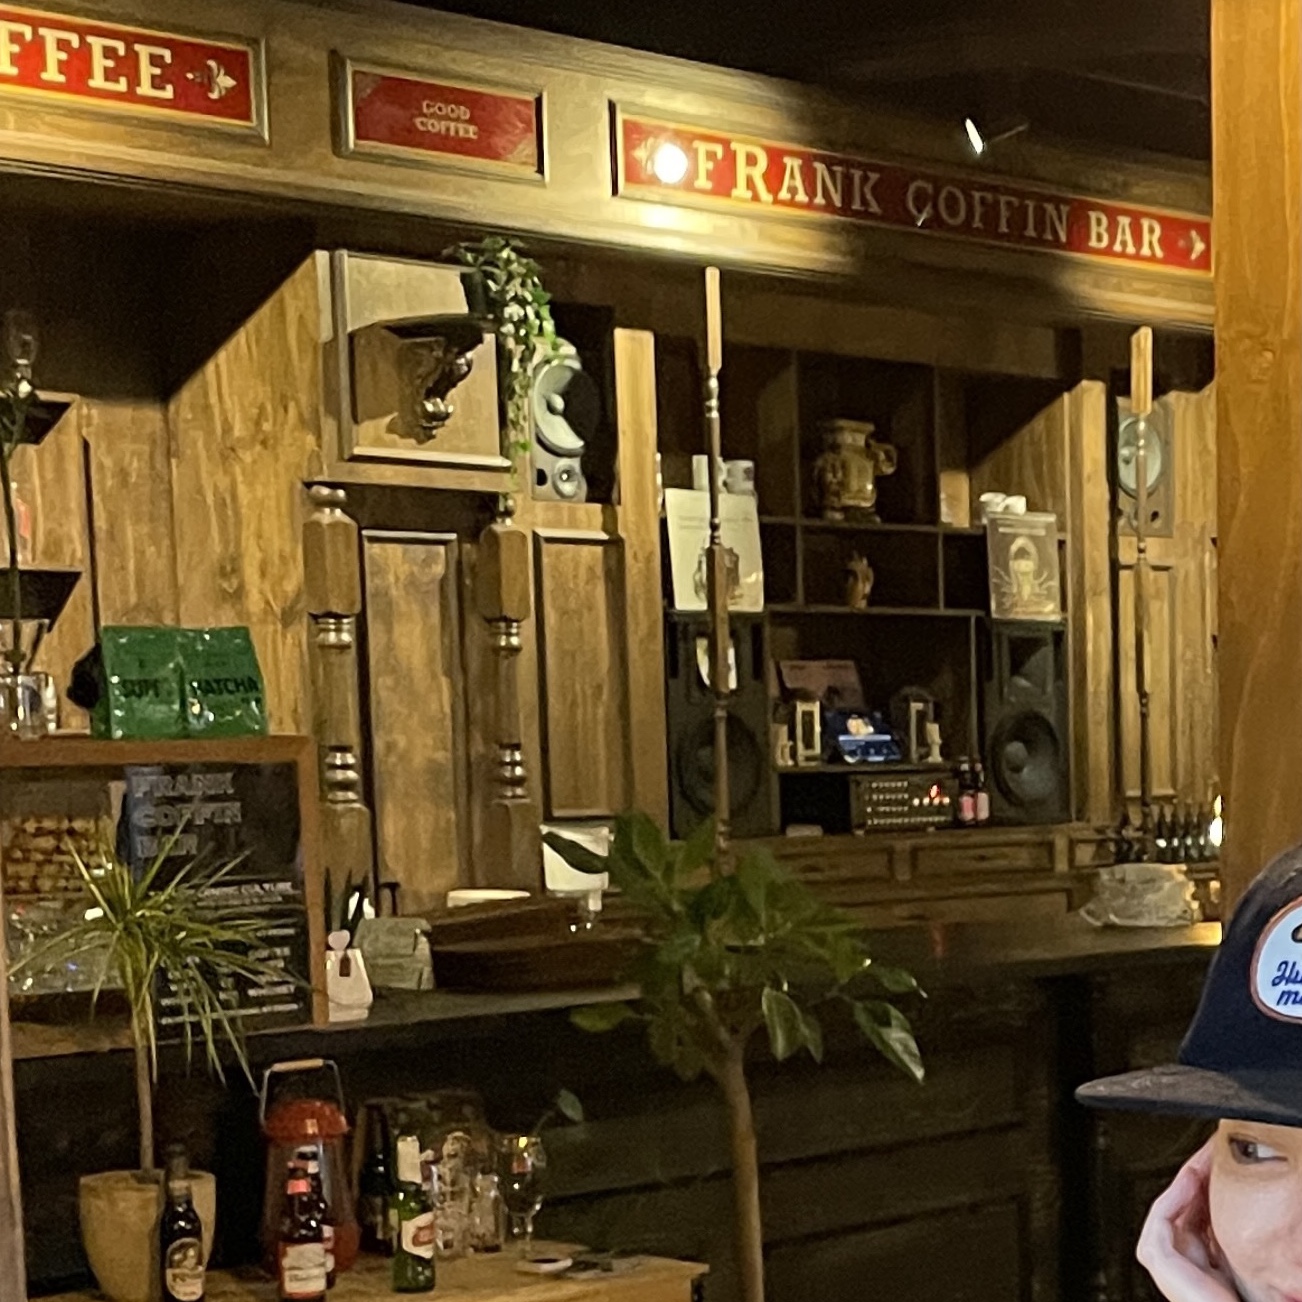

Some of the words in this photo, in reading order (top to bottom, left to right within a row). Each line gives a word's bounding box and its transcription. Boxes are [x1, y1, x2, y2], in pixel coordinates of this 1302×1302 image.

[422, 100, 470, 120] GOOD
[413, 117, 478, 139] COFFEE
[692, 140, 882, 216] FRANK
[906, 179, 1070, 243] COFFIN
[1087, 210, 1164, 258] BAR
